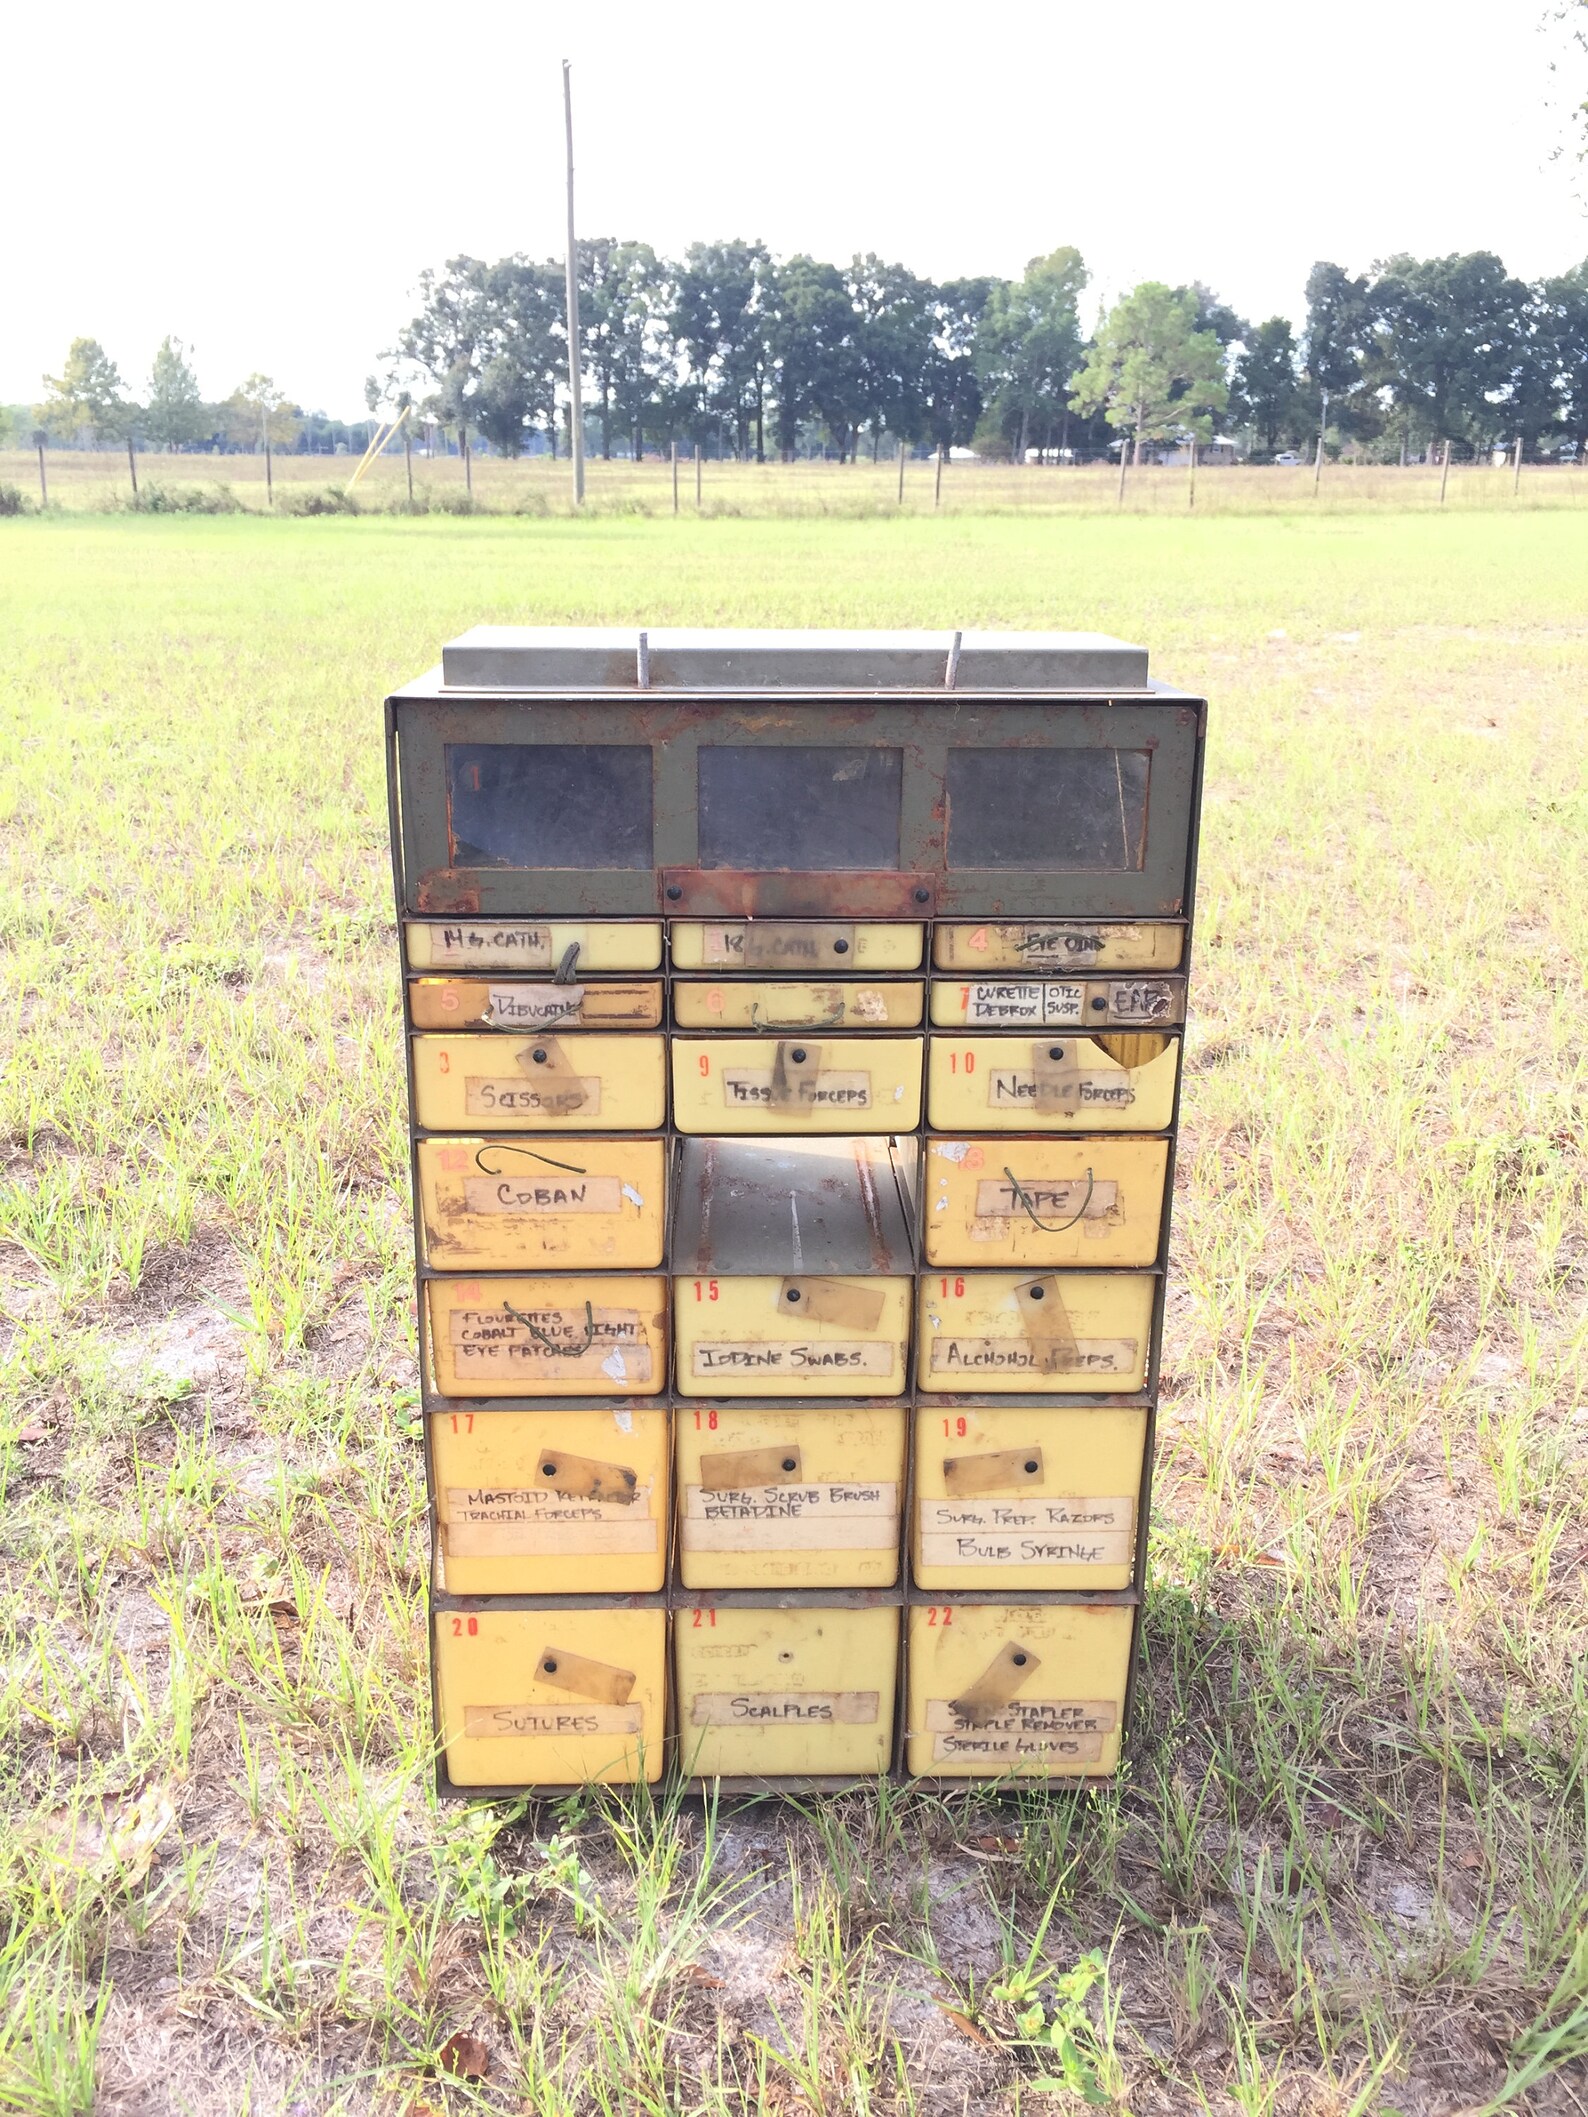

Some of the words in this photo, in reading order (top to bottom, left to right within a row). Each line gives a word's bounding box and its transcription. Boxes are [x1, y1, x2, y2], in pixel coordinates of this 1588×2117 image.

[968, 928, 989, 952] 4
[440, 988, 460, 1011] 5
[706, 989, 725, 1013] 6
[977, 985, 1040, 1001] CURETTE
[1048, 987, 1082, 1000] OTIC
[973, 1003, 1037, 1017] DEBROX
[1046, 1002, 1080, 1016] SUSP.
[699, 1055, 709, 1077] 9
[949, 1052, 975, 1074] 10
[497, 1183, 587, 1206] COBAN
[1000, 1186, 1070, 1211] TAPE
[452, 1282, 482, 1302] 14
[693, 1280, 719, 1301] 15
[940, 1277, 965, 1298] 16
[461, 1327, 516, 1340] COBALT
[530, 1326, 574, 1340] BLUE
[462, 1344, 500, 1357] EYE
[699, 1349, 783, 1368] IODINE
[790, 1347, 868, 1368] SWABS.
[450, 1414, 474, 1434] 17
[693, 1410, 718, 1431] 18
[943, 1417, 967, 1437] 19
[468, 1489, 549, 1506] MASTOID
[764, 1487, 820, 1503] SCRUB
[830, 1487, 880, 1503] BRUSH
[456, 1509, 531, 1521] TRACHIAL
[534, 1508, 603, 1521] FORCEPS
[705, 1503, 803, 1519] BETADINE
[1046, 1507, 1116, 1525] RAZORS
[957, 1537, 1012, 1560] BULB
[1020, 1540, 1106, 1562] SYRINGE
[452, 1617, 478, 1636] 20
[692, 1608, 716, 1628] 21
[927, 1607, 952, 1626] 22
[731, 1698, 833, 1719] SCALPLES
[1008, 1702, 1084, 1720] STAPLER
[493, 1711, 599, 1732] SUTURES
[942, 1735, 1009, 1753] STERILE
